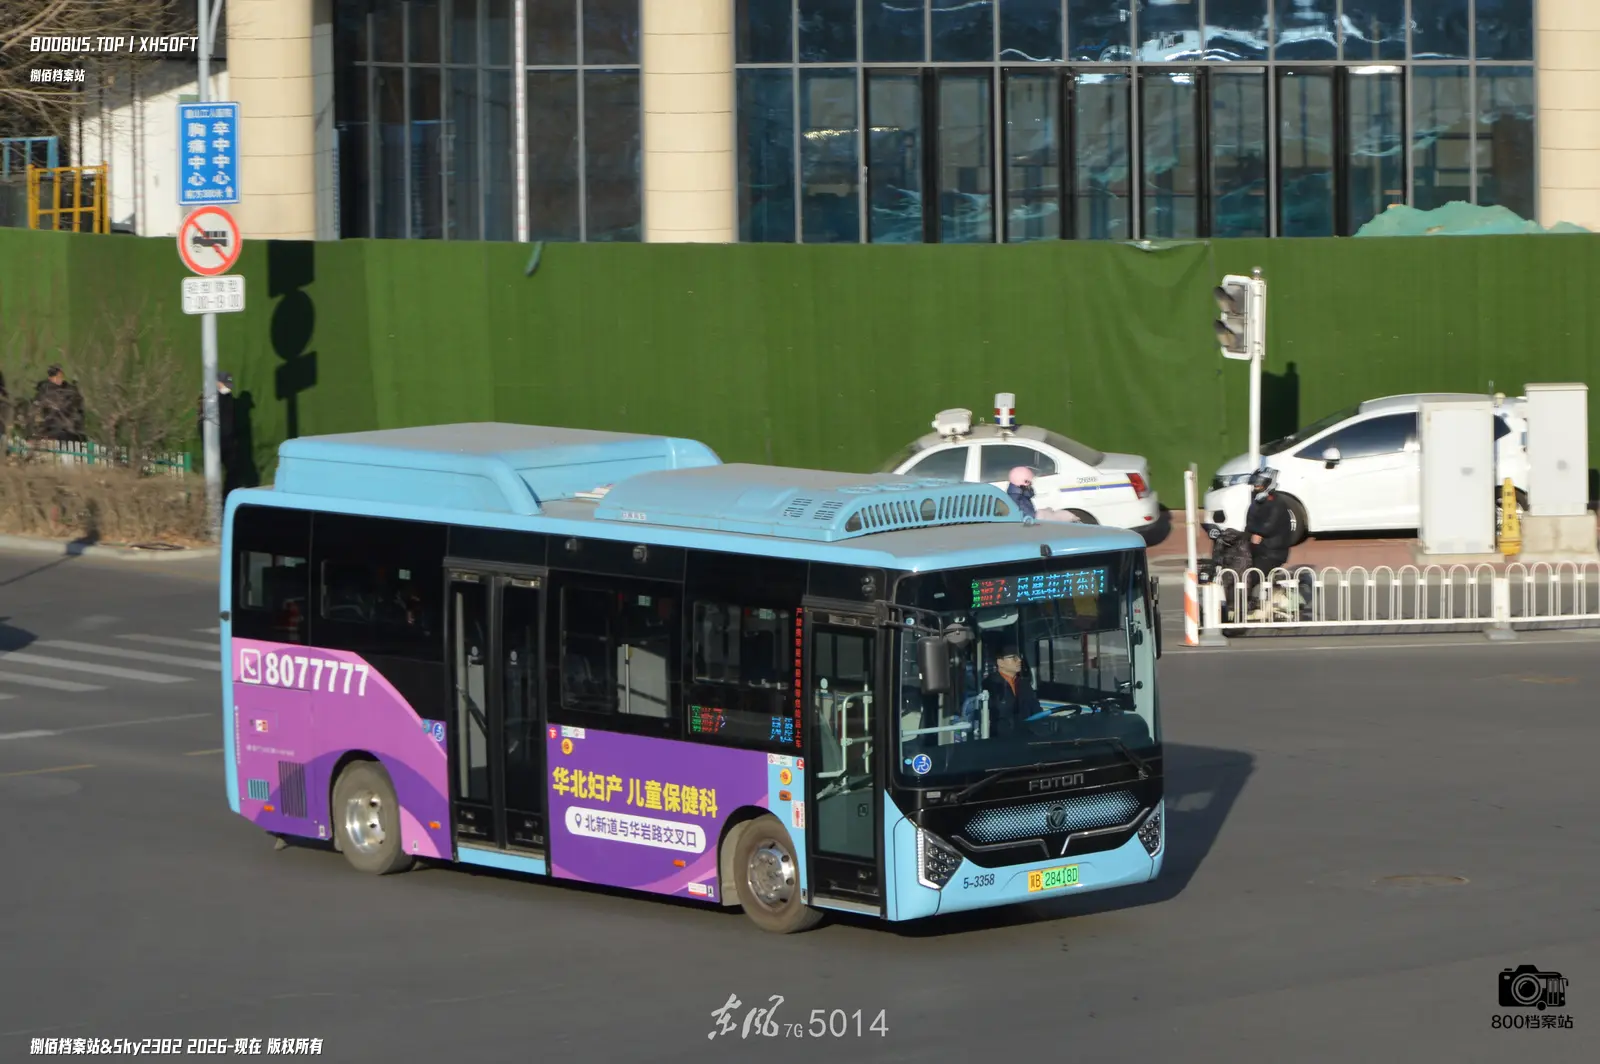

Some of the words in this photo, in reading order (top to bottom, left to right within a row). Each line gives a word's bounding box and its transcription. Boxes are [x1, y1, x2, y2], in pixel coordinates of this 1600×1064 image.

[265, 652, 369, 697] 8077777
[552, 766, 623, 802] 华北妇产
[626, 778, 718, 818] 儿童保健科
[1029, 773, 1084, 791] FOTON
[585, 814, 697, 848] 北新道与华岩路交叉口
[963, 873, 995, 890] 5-3358
